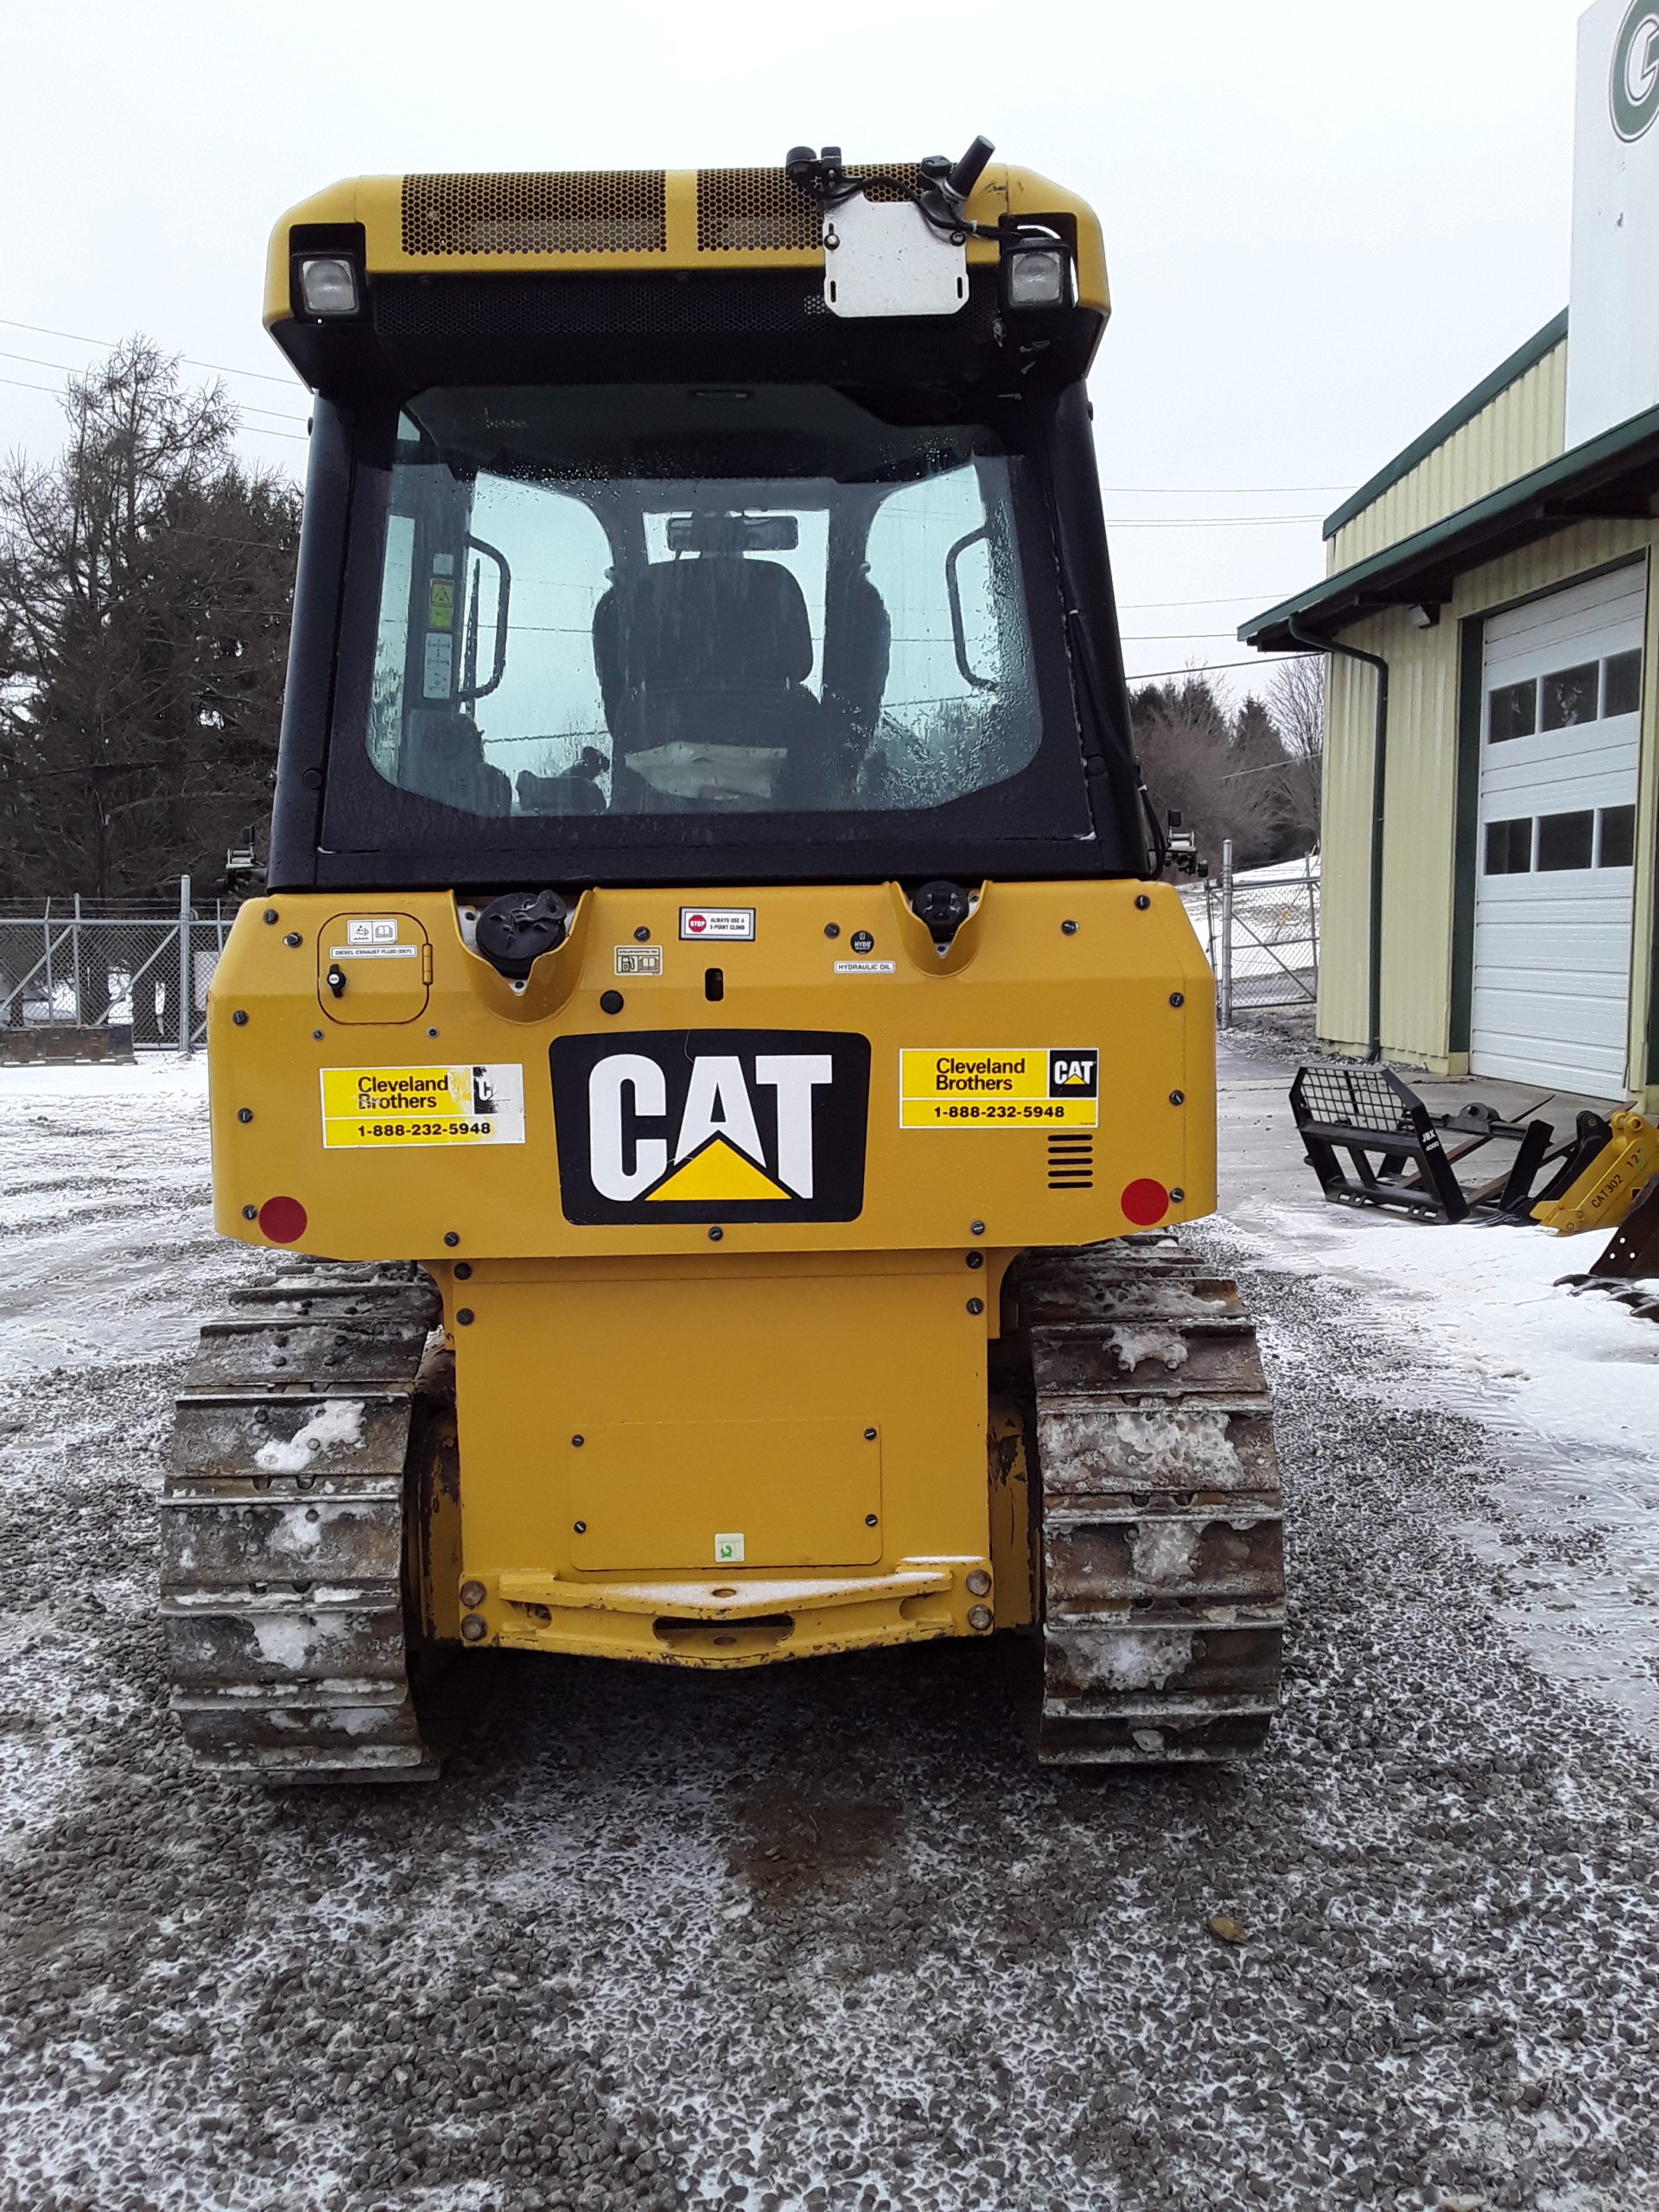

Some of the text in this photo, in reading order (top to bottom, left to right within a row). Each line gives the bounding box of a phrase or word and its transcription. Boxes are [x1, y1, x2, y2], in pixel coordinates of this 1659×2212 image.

[936, 1058, 1026, 1074] Cleveland
[1054, 1060, 1094, 1085] CAT
[358, 1075, 448, 1092] Cleveland
[936, 1075, 1013, 1090] Brothers
[359, 1093, 437, 1109] Brothers
[934, 1105, 1065, 1118] 1-888-232-5948
[358, 1122, 491, 1137] 1-888-232-5948
[589, 1053, 832, 1201] CAT
[1422, 1128, 1436, 1142] JBX
